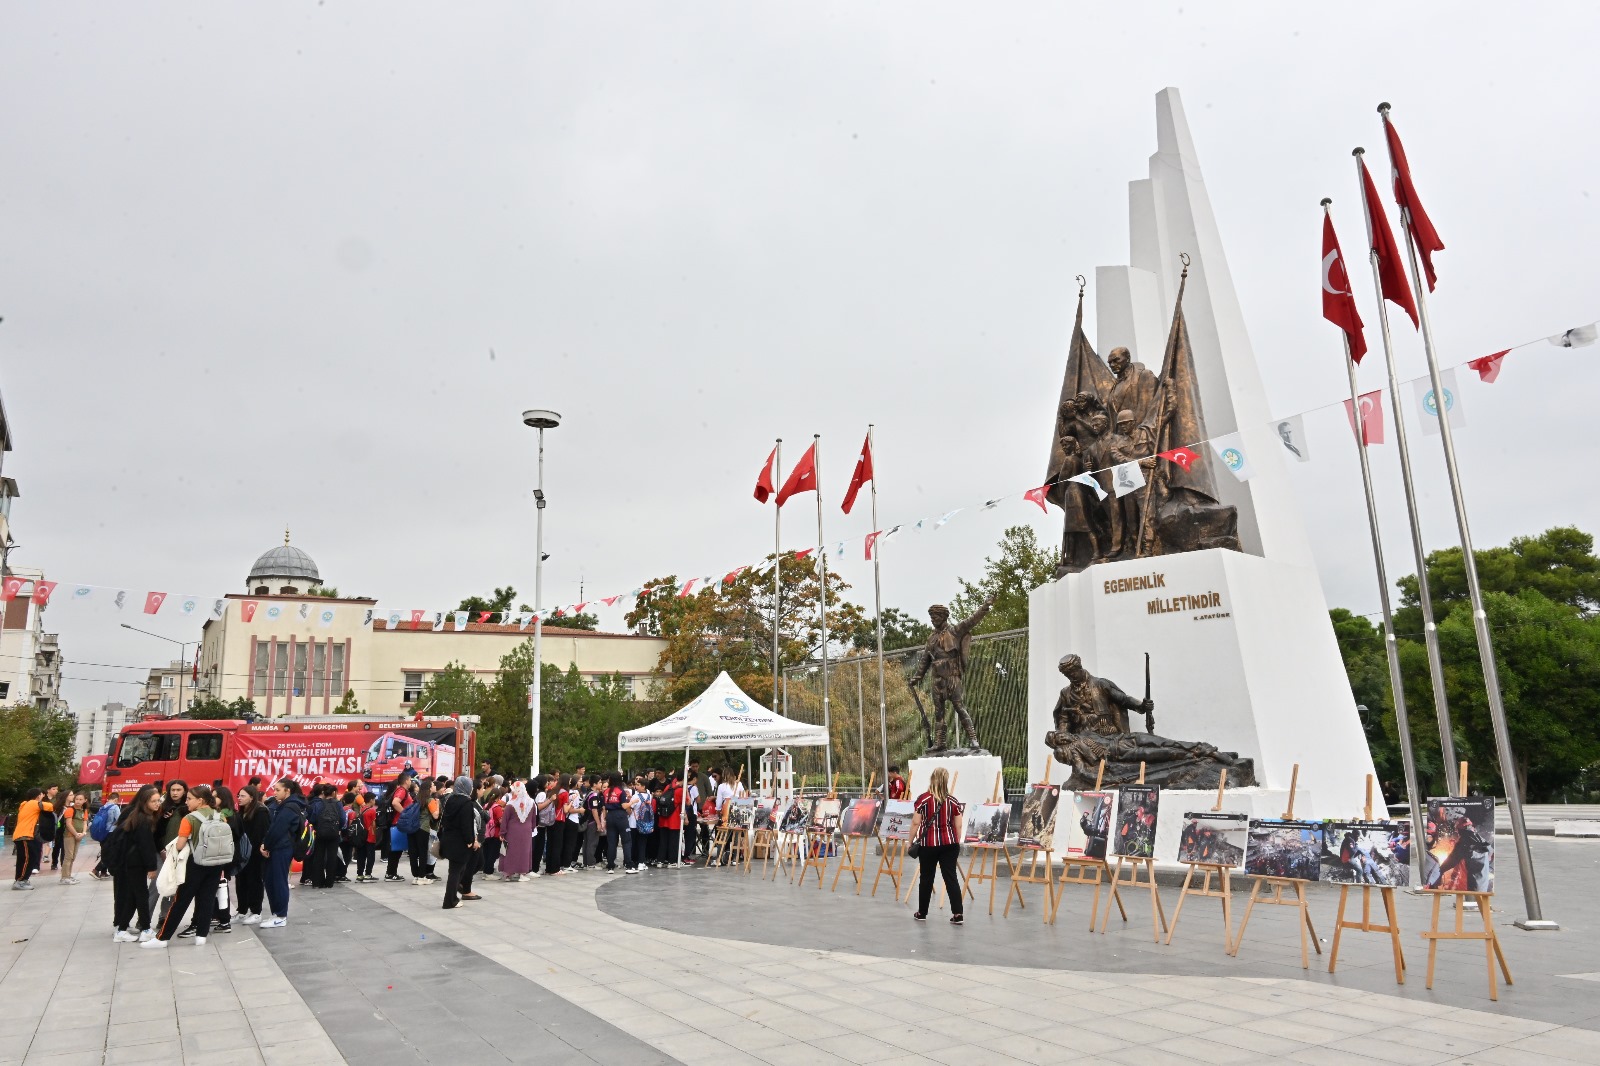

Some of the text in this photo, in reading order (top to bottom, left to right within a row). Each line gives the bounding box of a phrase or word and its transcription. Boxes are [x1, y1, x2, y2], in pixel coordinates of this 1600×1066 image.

[1104, 572, 1166, 594] EGEMENLİK
[1147, 591, 1221, 615] MİLLETİNDİR
[234, 758, 293, 776] İTFAİYE
[297, 756, 362, 775] HAFTASI
